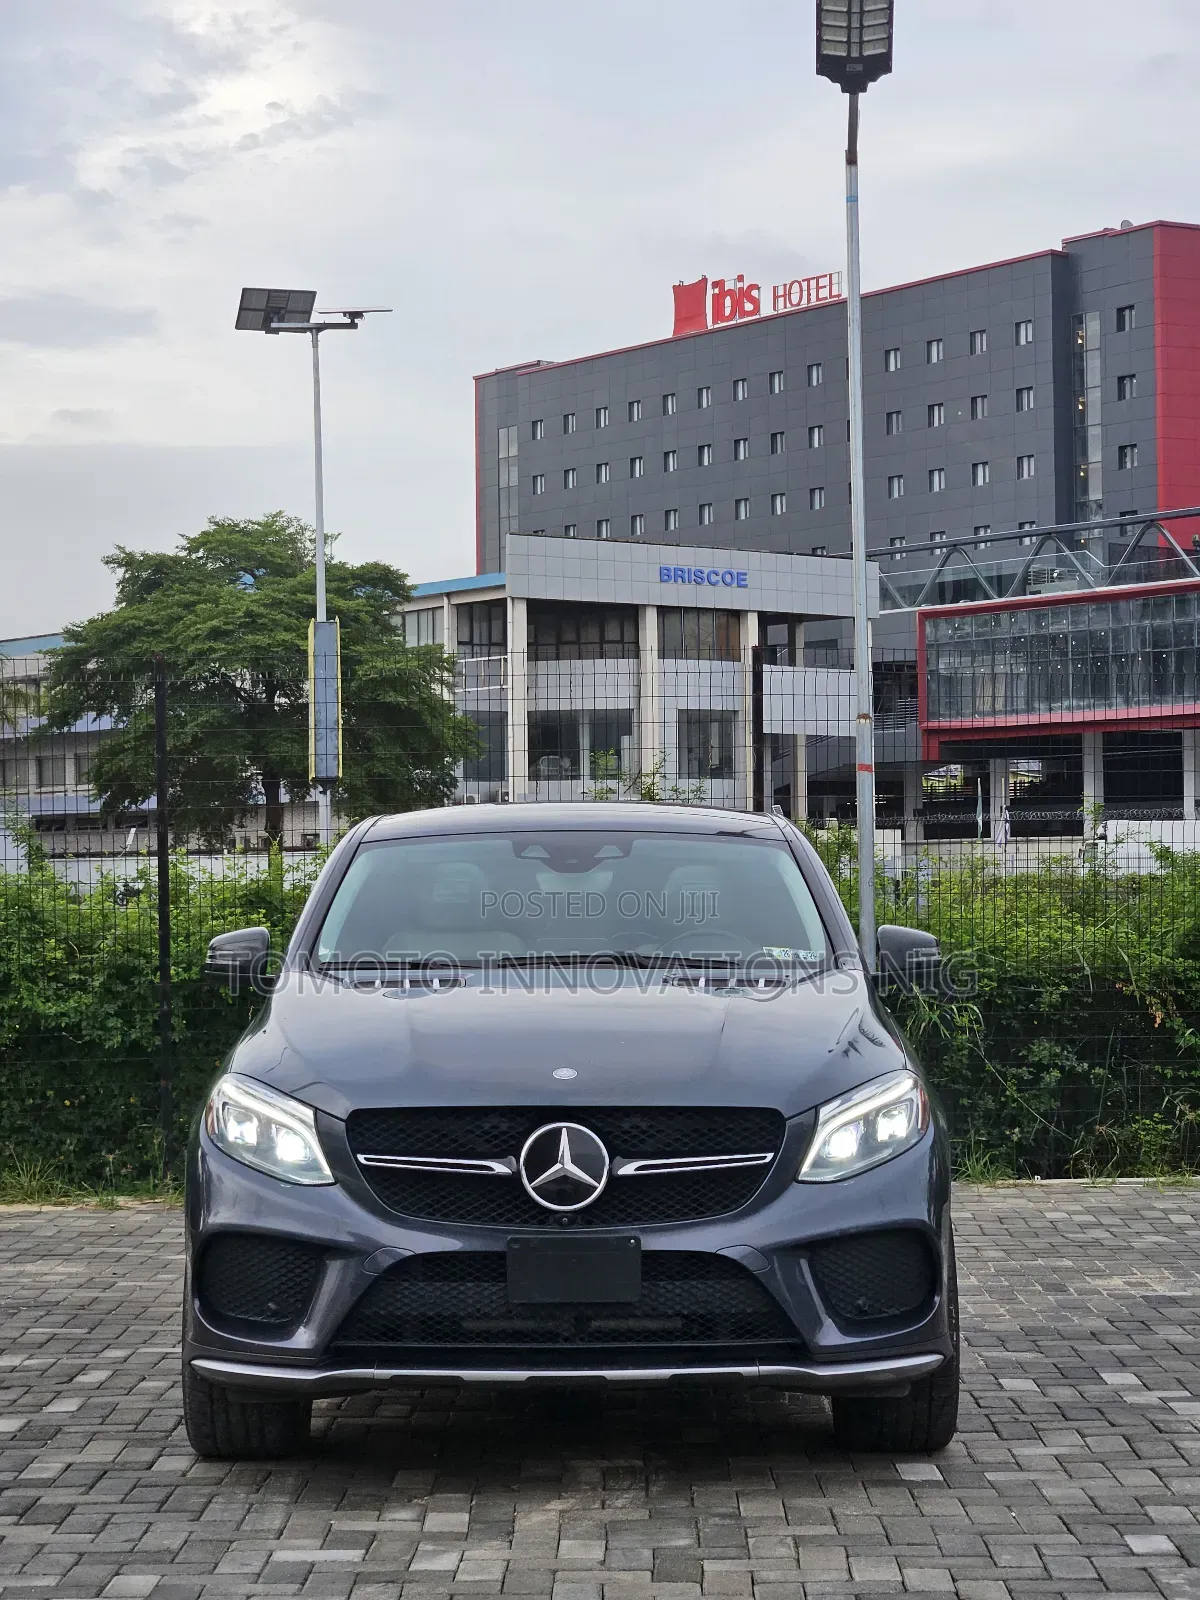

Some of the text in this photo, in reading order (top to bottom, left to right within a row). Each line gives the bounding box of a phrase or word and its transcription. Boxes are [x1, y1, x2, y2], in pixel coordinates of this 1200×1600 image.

[712, 272, 842, 325] ibis HOTEL
[660, 566, 748, 588] BRISCOE
